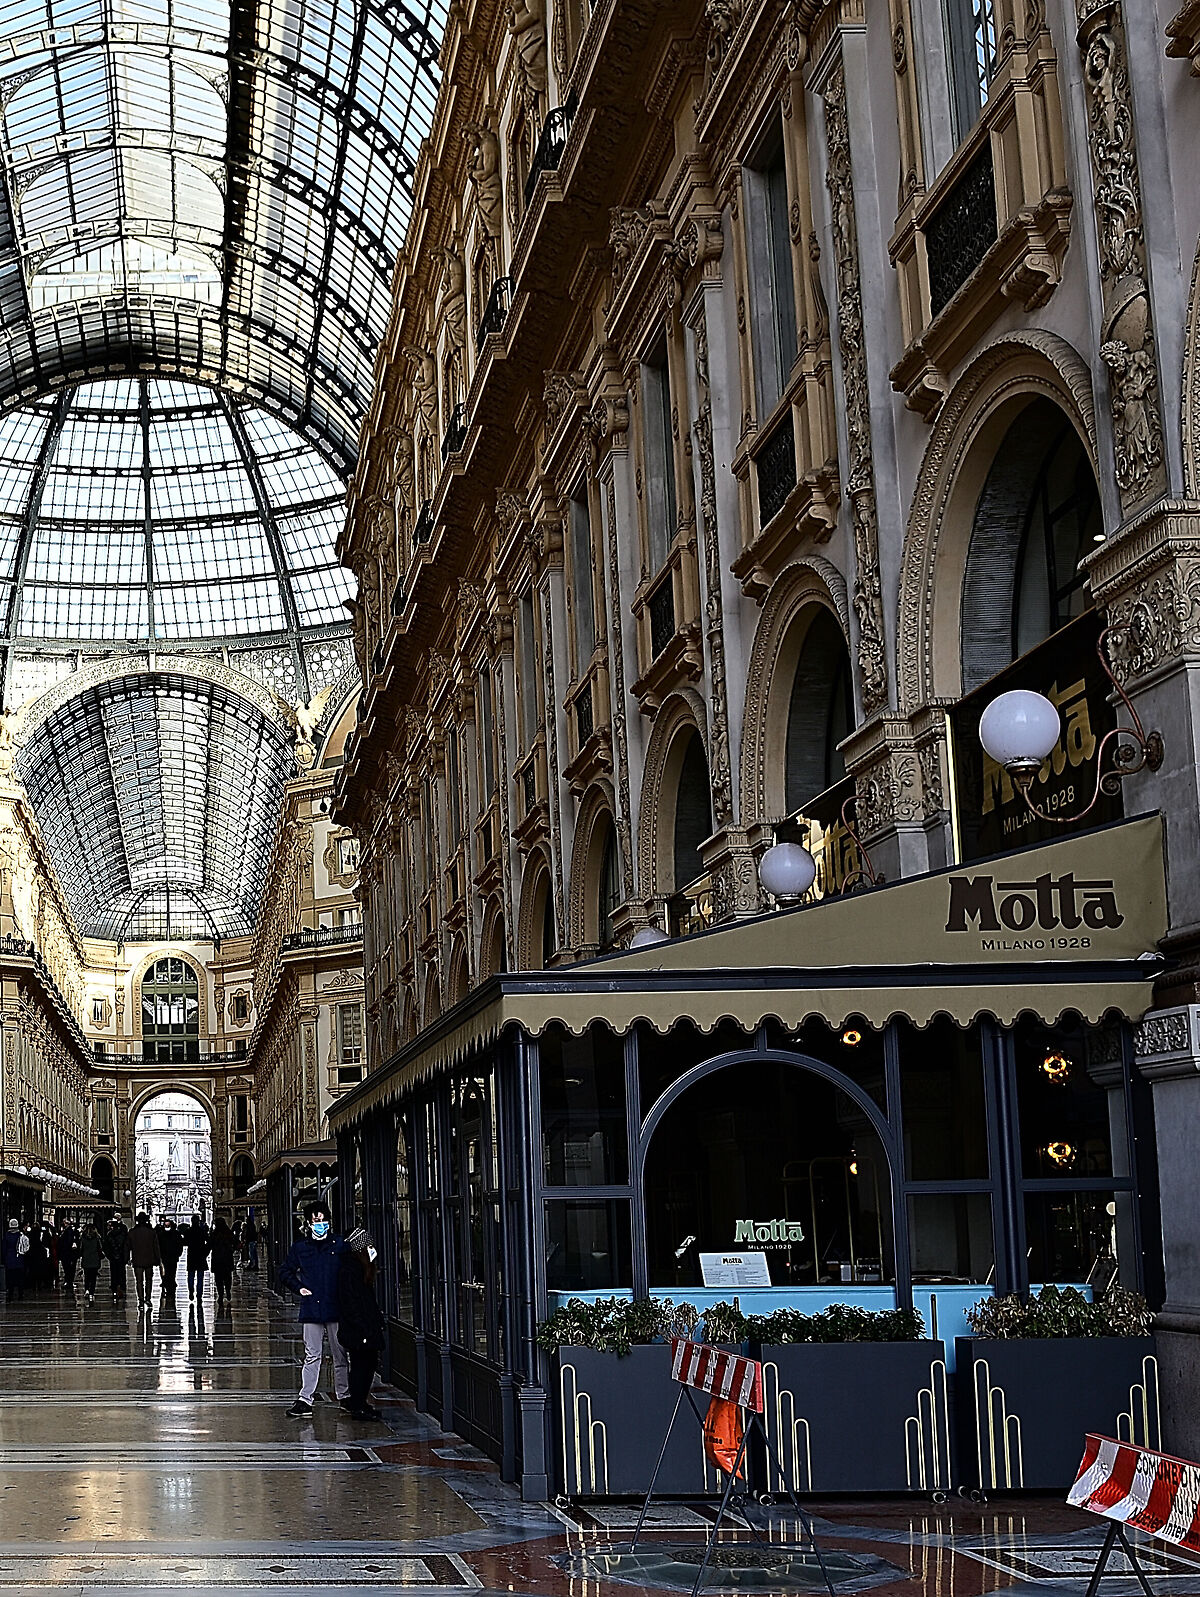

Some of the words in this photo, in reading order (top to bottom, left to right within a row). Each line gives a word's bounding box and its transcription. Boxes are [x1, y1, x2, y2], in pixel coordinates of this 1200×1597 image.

[1046, 785, 1075, 813] 1928
[945, 872, 1125, 932] Motta
[981, 938, 1045, 951] MILANO
[1050, 937, 1091, 950] 1928
[734, 1218, 805, 1242] Motta
[722, 1257, 743, 1265] Motta
[1136, 1453, 1178, 1486] COMUNE
[1127, 1506, 1164, 1532] Nucleo
